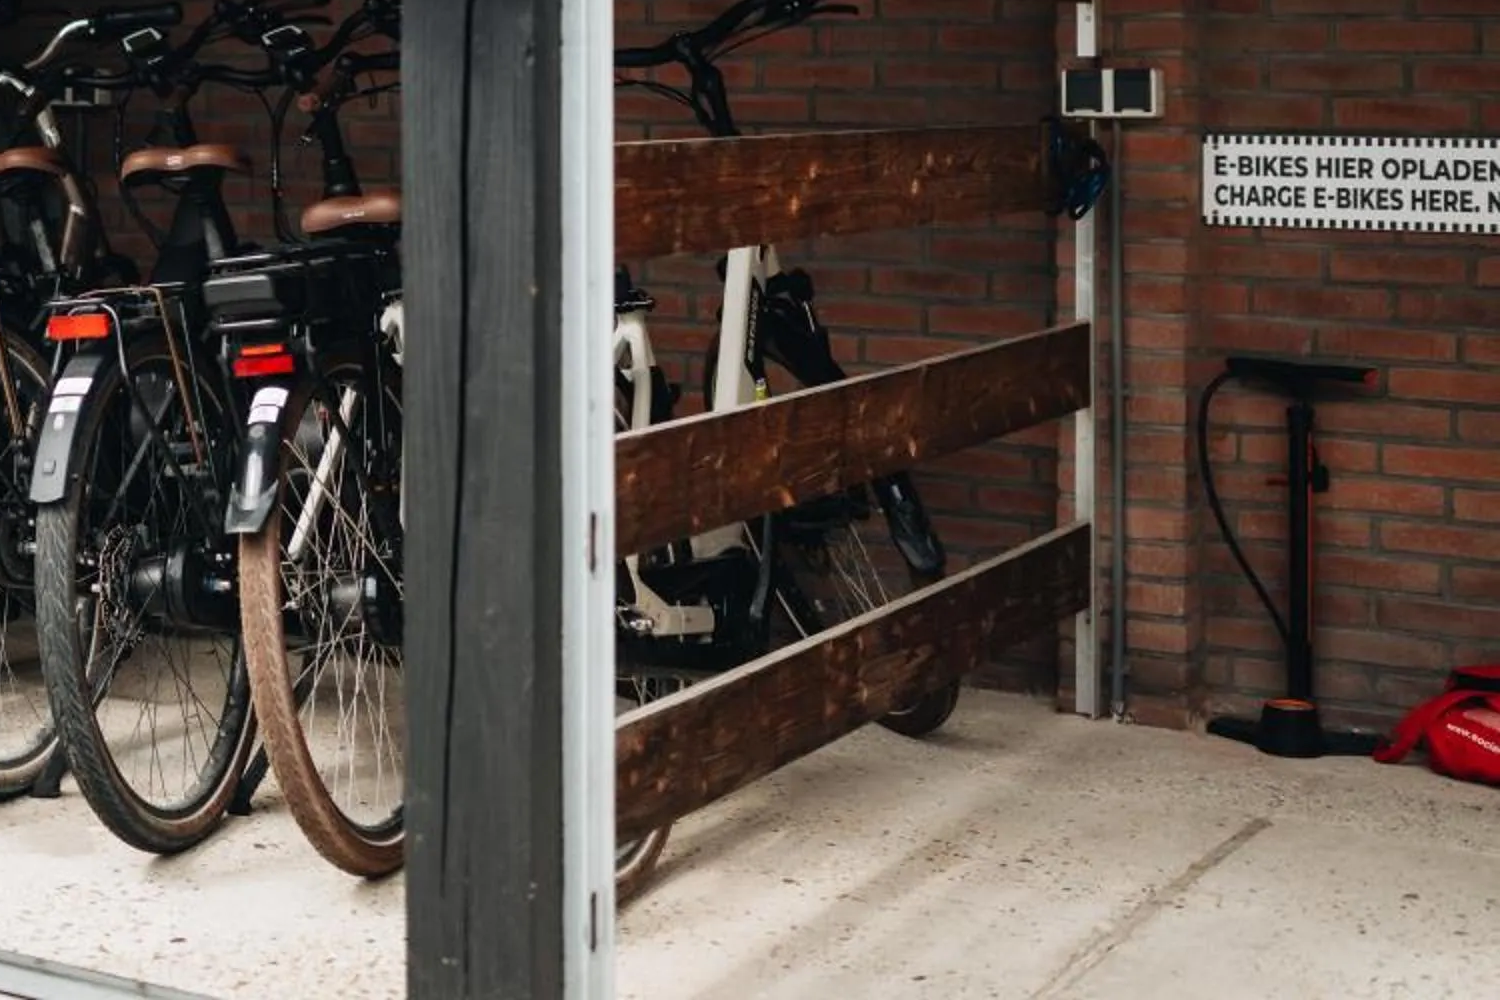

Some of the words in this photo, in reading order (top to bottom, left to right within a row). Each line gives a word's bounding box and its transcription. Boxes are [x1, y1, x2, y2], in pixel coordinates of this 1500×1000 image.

[1214, 155, 1308, 178] E-BIKES
[1316, 157, 1374, 180] HIER
[1381, 158, 1500, 182] OPLADEN
[1214, 184, 1306, 208] CHARGE
[1313, 186, 1403, 210] E-BIKES
[1411, 189, 1480, 213] HERE.
